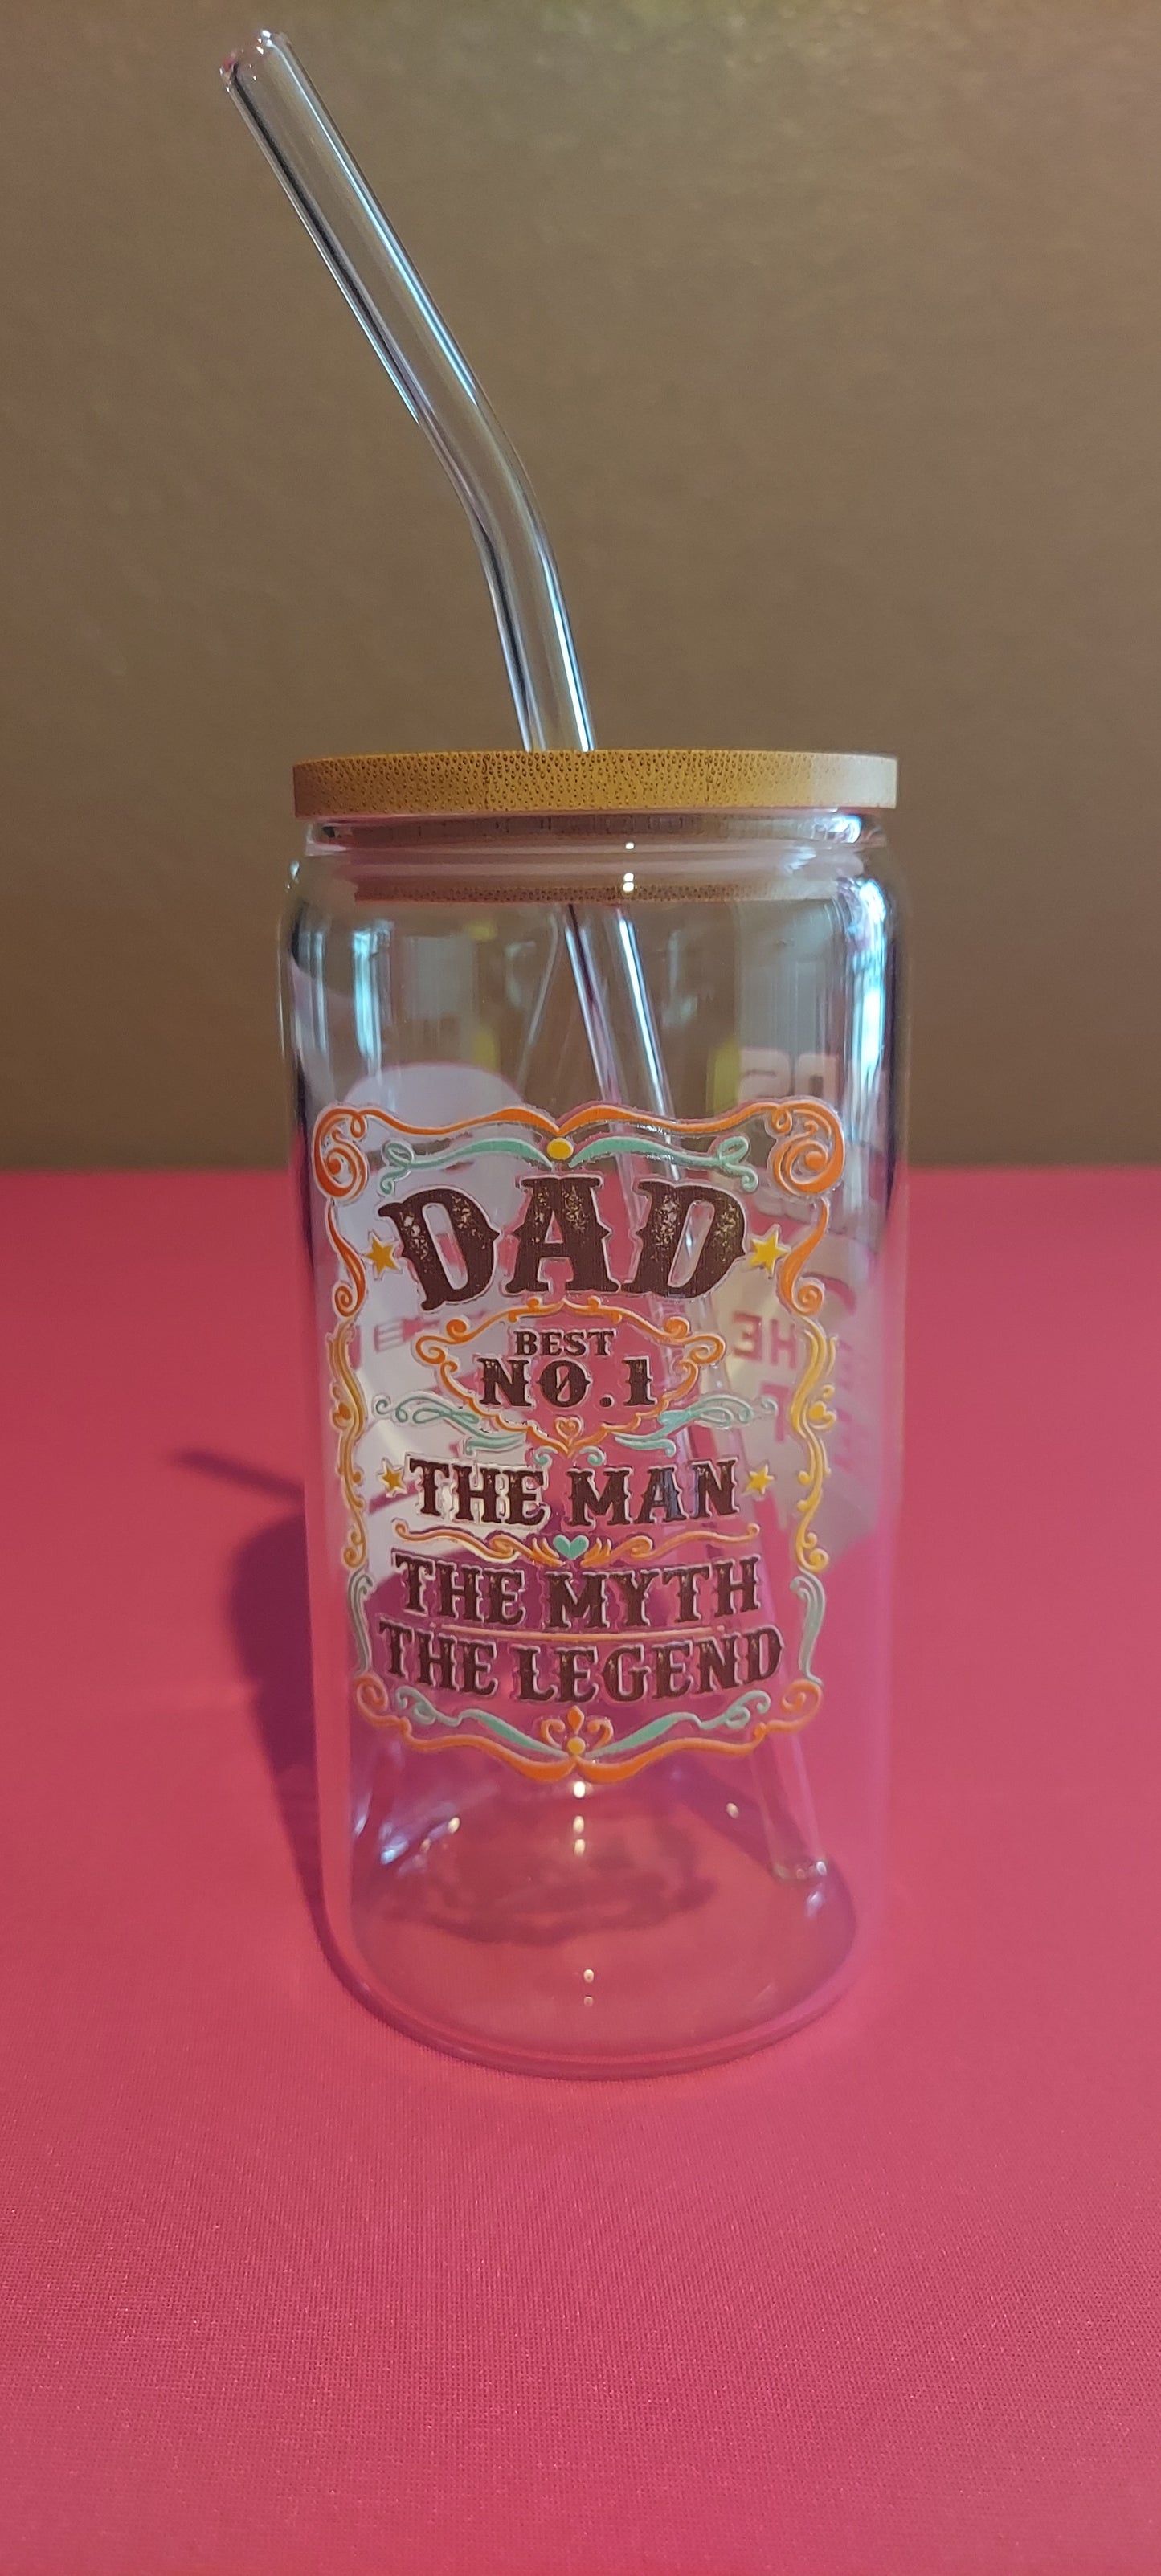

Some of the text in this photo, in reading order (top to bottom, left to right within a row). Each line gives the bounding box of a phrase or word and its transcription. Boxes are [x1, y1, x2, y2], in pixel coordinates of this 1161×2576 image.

[378, 1176, 746, 1310] DAD
[515, 1331, 614, 1355] BEST
[479, 1357, 658, 1408] NO.1
[407, 1458, 738, 1526] THE MAN
[395, 1555, 760, 1628] THE MYTH
[378, 1621, 783, 1702] THE LEGEND
